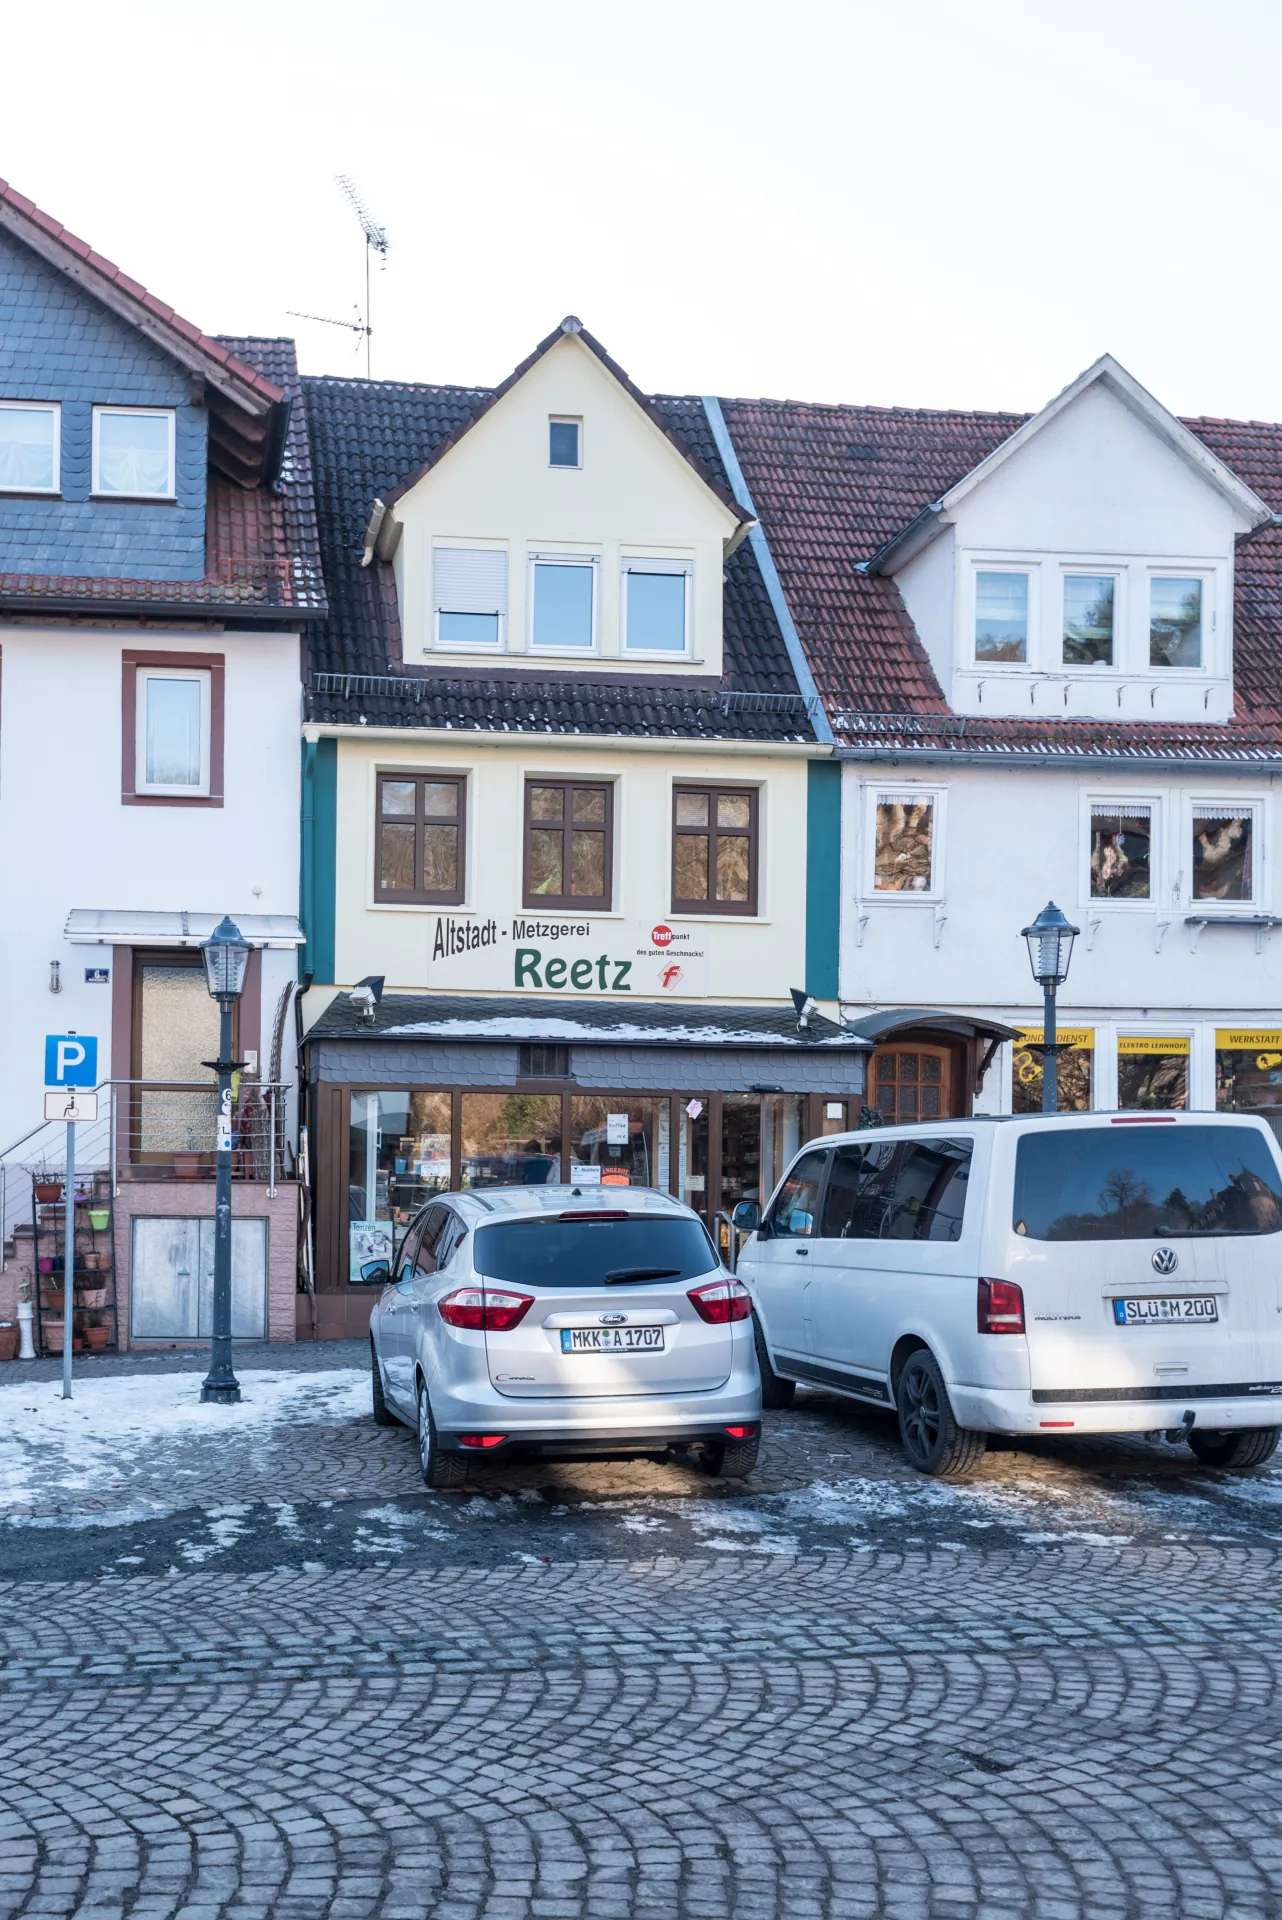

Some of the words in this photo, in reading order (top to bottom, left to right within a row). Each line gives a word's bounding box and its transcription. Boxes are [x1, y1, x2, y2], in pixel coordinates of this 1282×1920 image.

[433, 917, 497, 961] Altstadt
[512, 920, 590, 940] Metzgerei
[648, 949, 665, 957] guten
[514, 948, 633, 991] Reetz
[1151, 1042, 1187, 1050] LEHNHOFF
[1229, 1035, 1280, 1044] WERKSTATT
[56, 1041, 86, 1081] P
[225, 1090, 232, 1101] 6
[352, 1222, 376, 1231] Tanzen
[1126, 1301, 1159, 1318] SLÜ
[1169, 1301, 1181, 1317] M
[1183, 1300, 1215, 1316] 200
[572, 1331, 601, 1348] MKK
[613, 1331, 622, 1347] A
[625, 1329, 661, 1346] 1707
